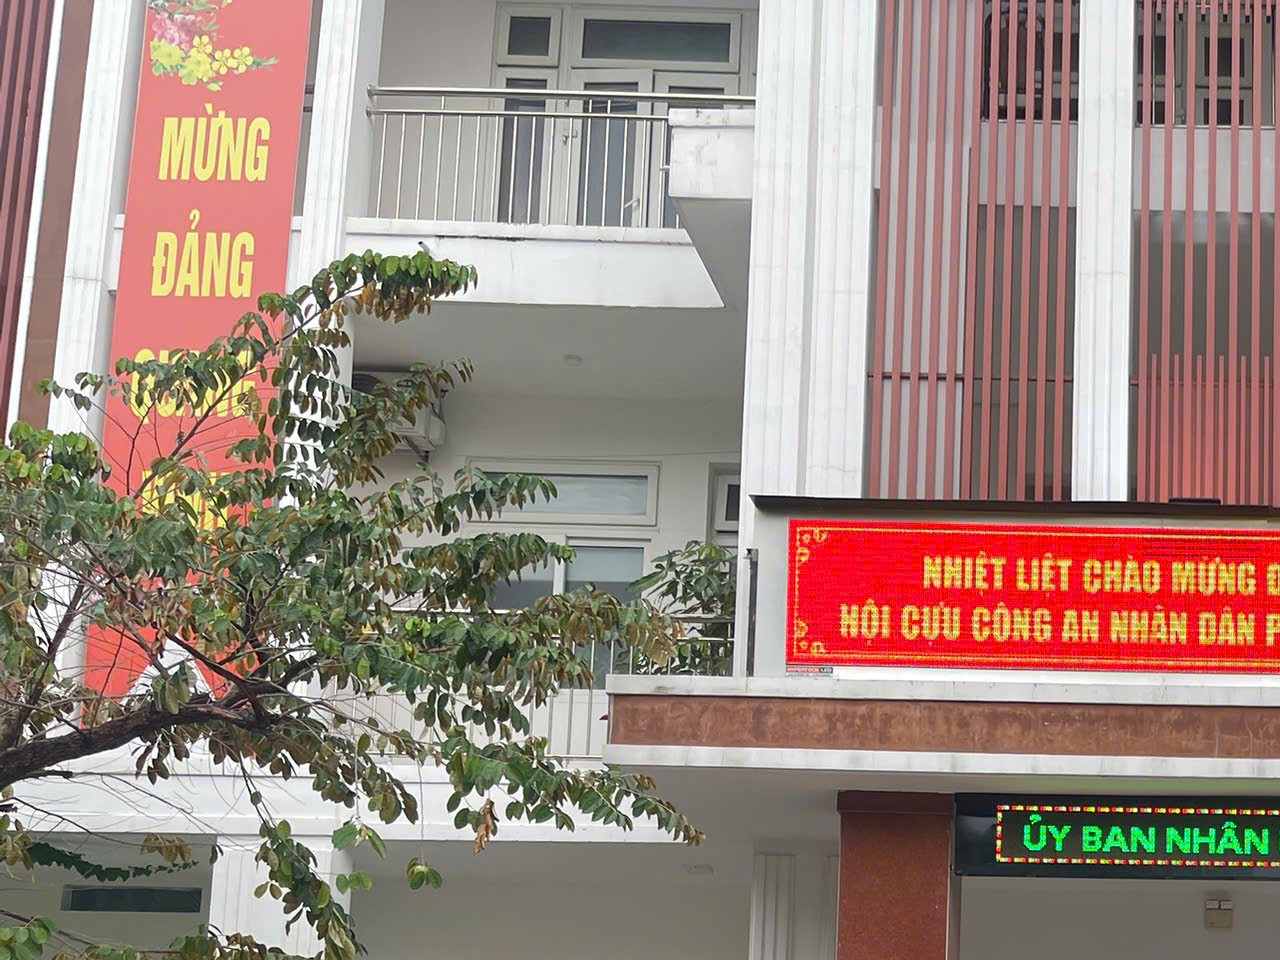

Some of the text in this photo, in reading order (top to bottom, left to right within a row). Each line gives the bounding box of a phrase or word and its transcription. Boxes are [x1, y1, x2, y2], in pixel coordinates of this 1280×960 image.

[158, 103, 271, 182] MỪNG
[151, 208, 256, 298] ĐẢNG
[923, 551, 1006, 597] NHIỆT
[1016, 552, 1072, 597] LIỆT
[1083, 554, 1161, 594] CHÀO
[1171, 556, 1256, 596] MỪNG
[839, 598, 890, 646] HỘI
[901, 601, 961, 647] CỰU
[971, 601, 1052, 643] CÔNG
[1061, 608, 1100, 644] AN
[1110, 604, 1188, 645] NHÂN
[1198, 605, 1256, 646] DÂN
[1023, 814, 1072, 852] ỦY
[1082, 825, 1156, 853] BAN
[1166, 821, 1269, 855] NHÂN
